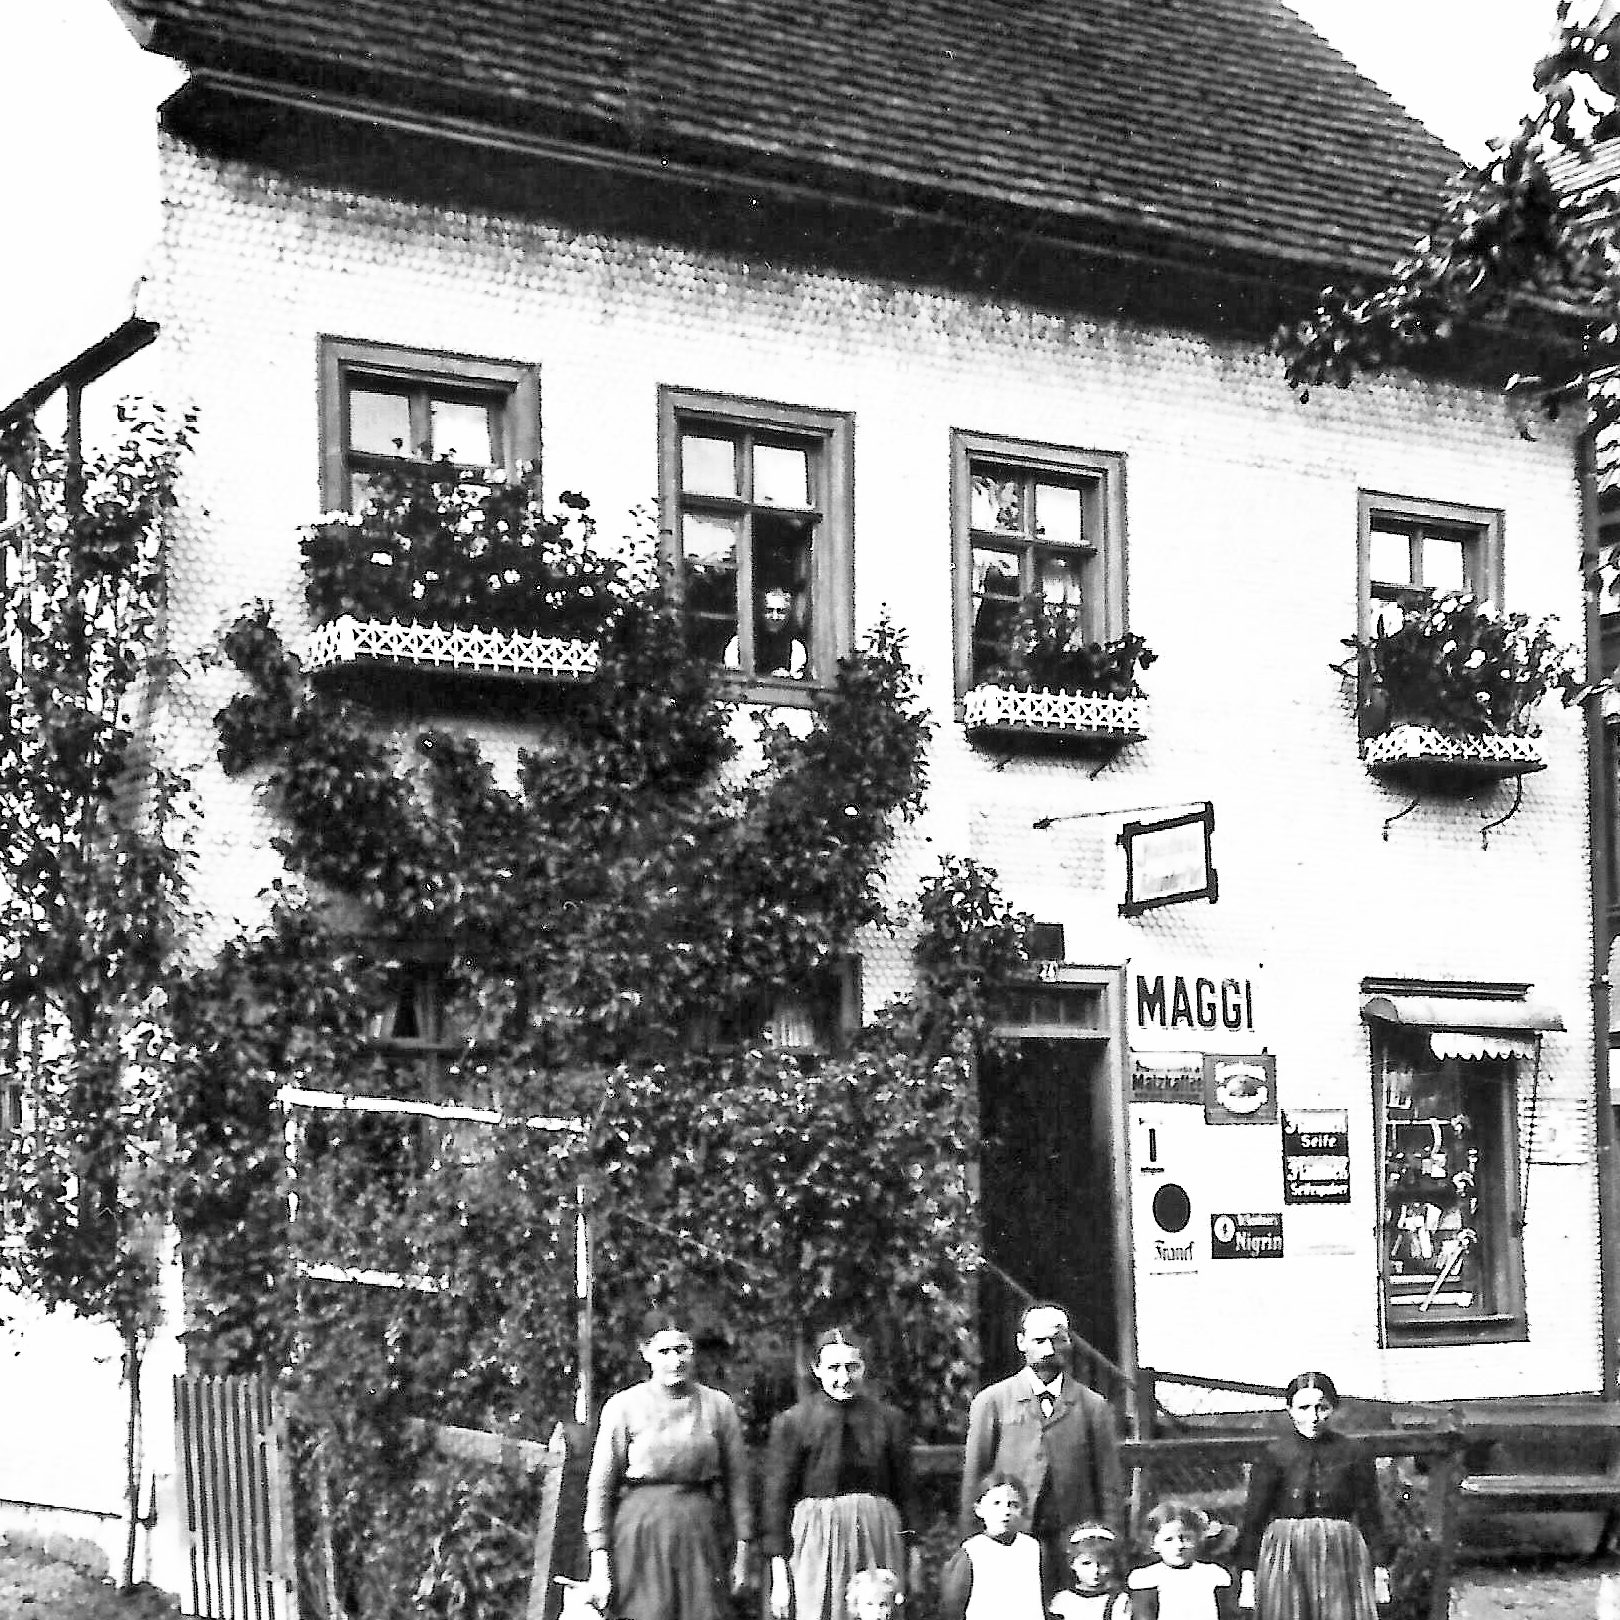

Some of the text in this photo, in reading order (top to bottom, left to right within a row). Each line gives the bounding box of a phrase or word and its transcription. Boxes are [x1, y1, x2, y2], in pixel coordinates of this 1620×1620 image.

[1137, 976, 1253, 1031] MAGGI
[1301, 1134, 1336, 1147] Seife
[1235, 1231, 1282, 1257] Nigrin
